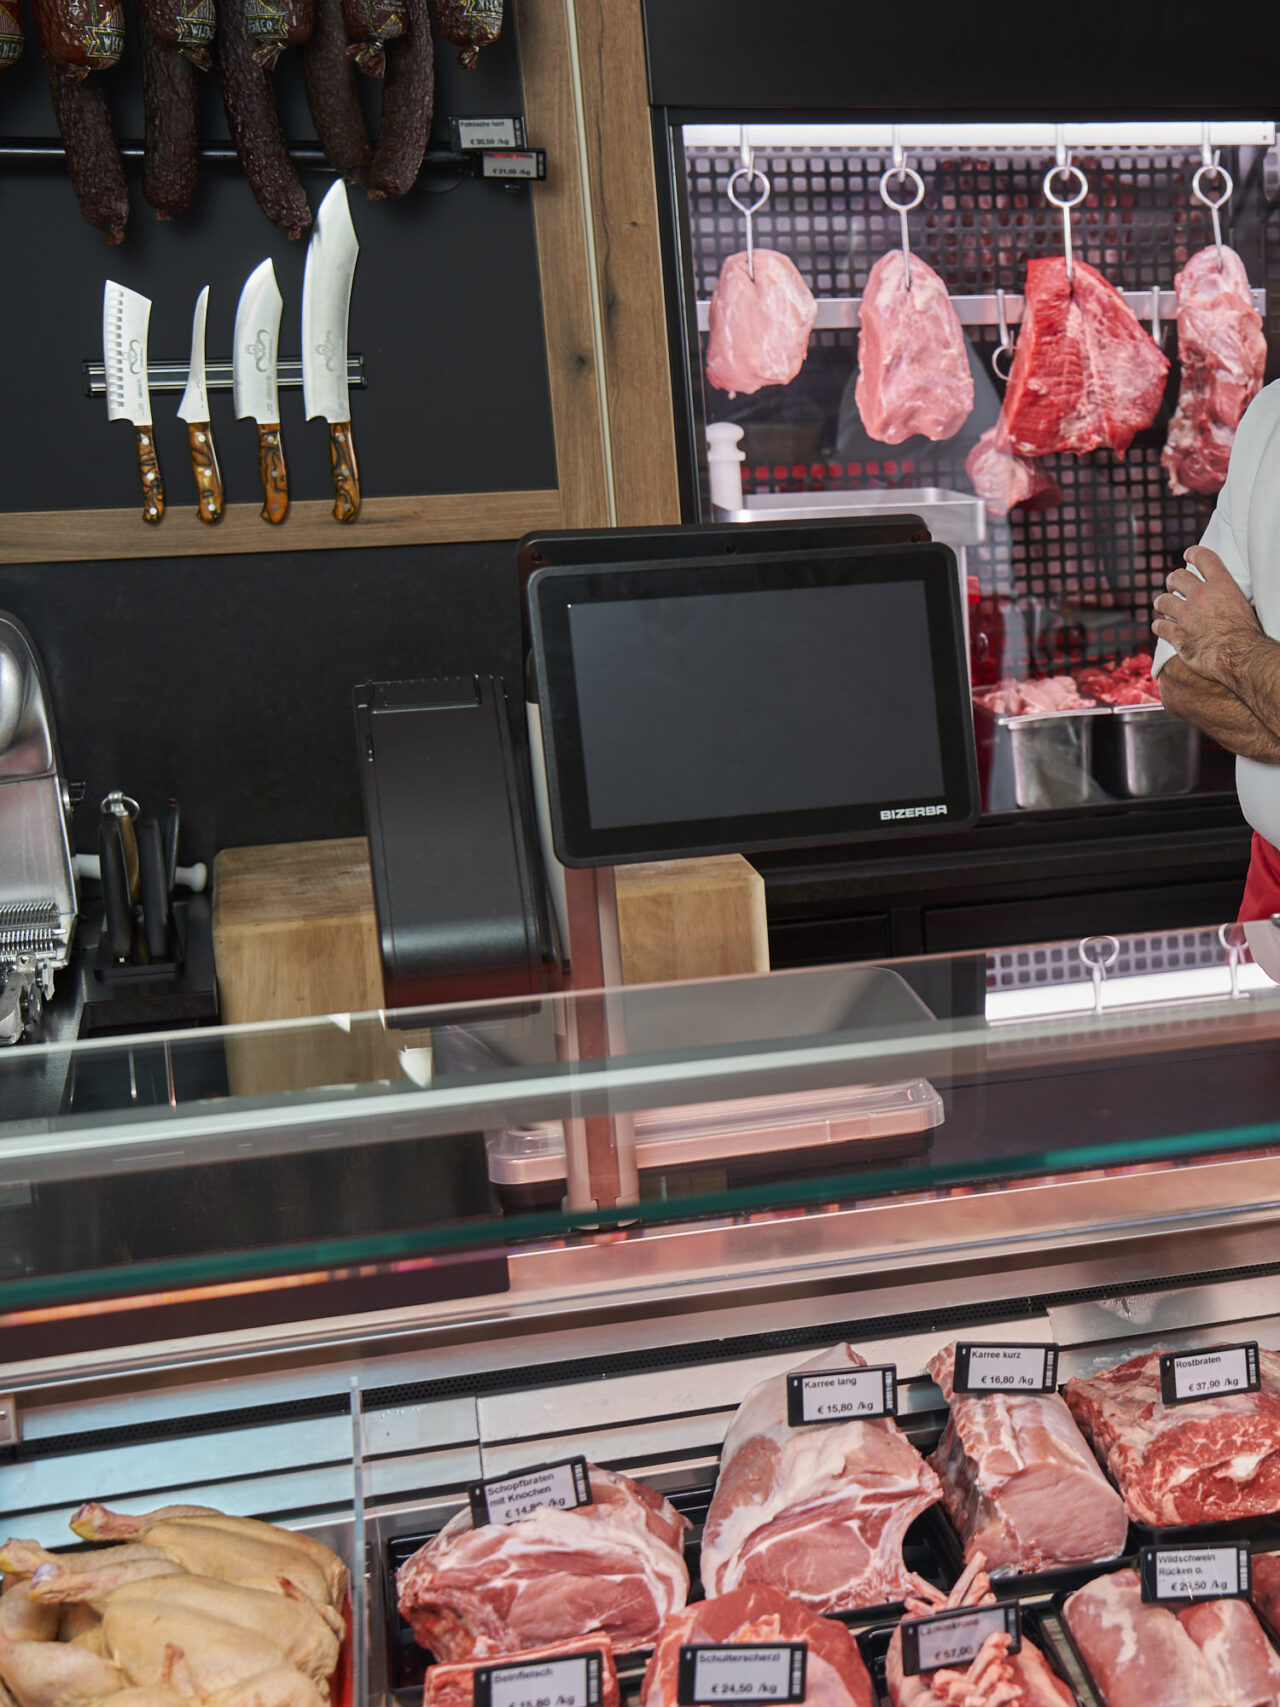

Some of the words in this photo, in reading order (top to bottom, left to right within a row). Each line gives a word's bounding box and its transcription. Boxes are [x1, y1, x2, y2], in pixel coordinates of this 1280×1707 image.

[880, 804, 947, 820] BIZERBA
[971, 1350, 1000, 1359] Karree
[1002, 1351, 1021, 1359] kurz
[1176, 1356, 1221, 1368] Rostbraten
[804, 1380, 835, 1388] Karree
[837, 1377, 857, 1386] lang
[981, 1375, 988, 1384] €
[990, 1375, 1014, 1385] 16,80
[1018, 1375, 1034, 1386] /kg
[1188, 1383, 1195, 1392] €
[1197, 1380, 1220, 1391] 37,90
[1224, 1378, 1239, 1386] /kg
[818, 1405, 825, 1414] €
[827, 1403, 853, 1413] 15,80
[857, 1401, 874, 1411] /kg
[488, 1473, 554, 1496] Schopfbraten
[490, 1497, 507, 1507] mit
[508, 1486, 552, 1501] Knochen
[506, 1509, 513, 1518] €
[1158, 1554, 1216, 1564] Wildschwein
[1159, 1567, 1193, 1576] Rücken
[1171, 1583, 1177, 1591] €
[700, 1653, 780, 1663] Schulterscherzl
[935, 1651, 942, 1660] €
[711, 1684, 718, 1693] €
[721, 1683, 753, 1694] 24,50
[759, 1683, 777, 1694] /kg
[556, 1695, 575, 1705] /kg
